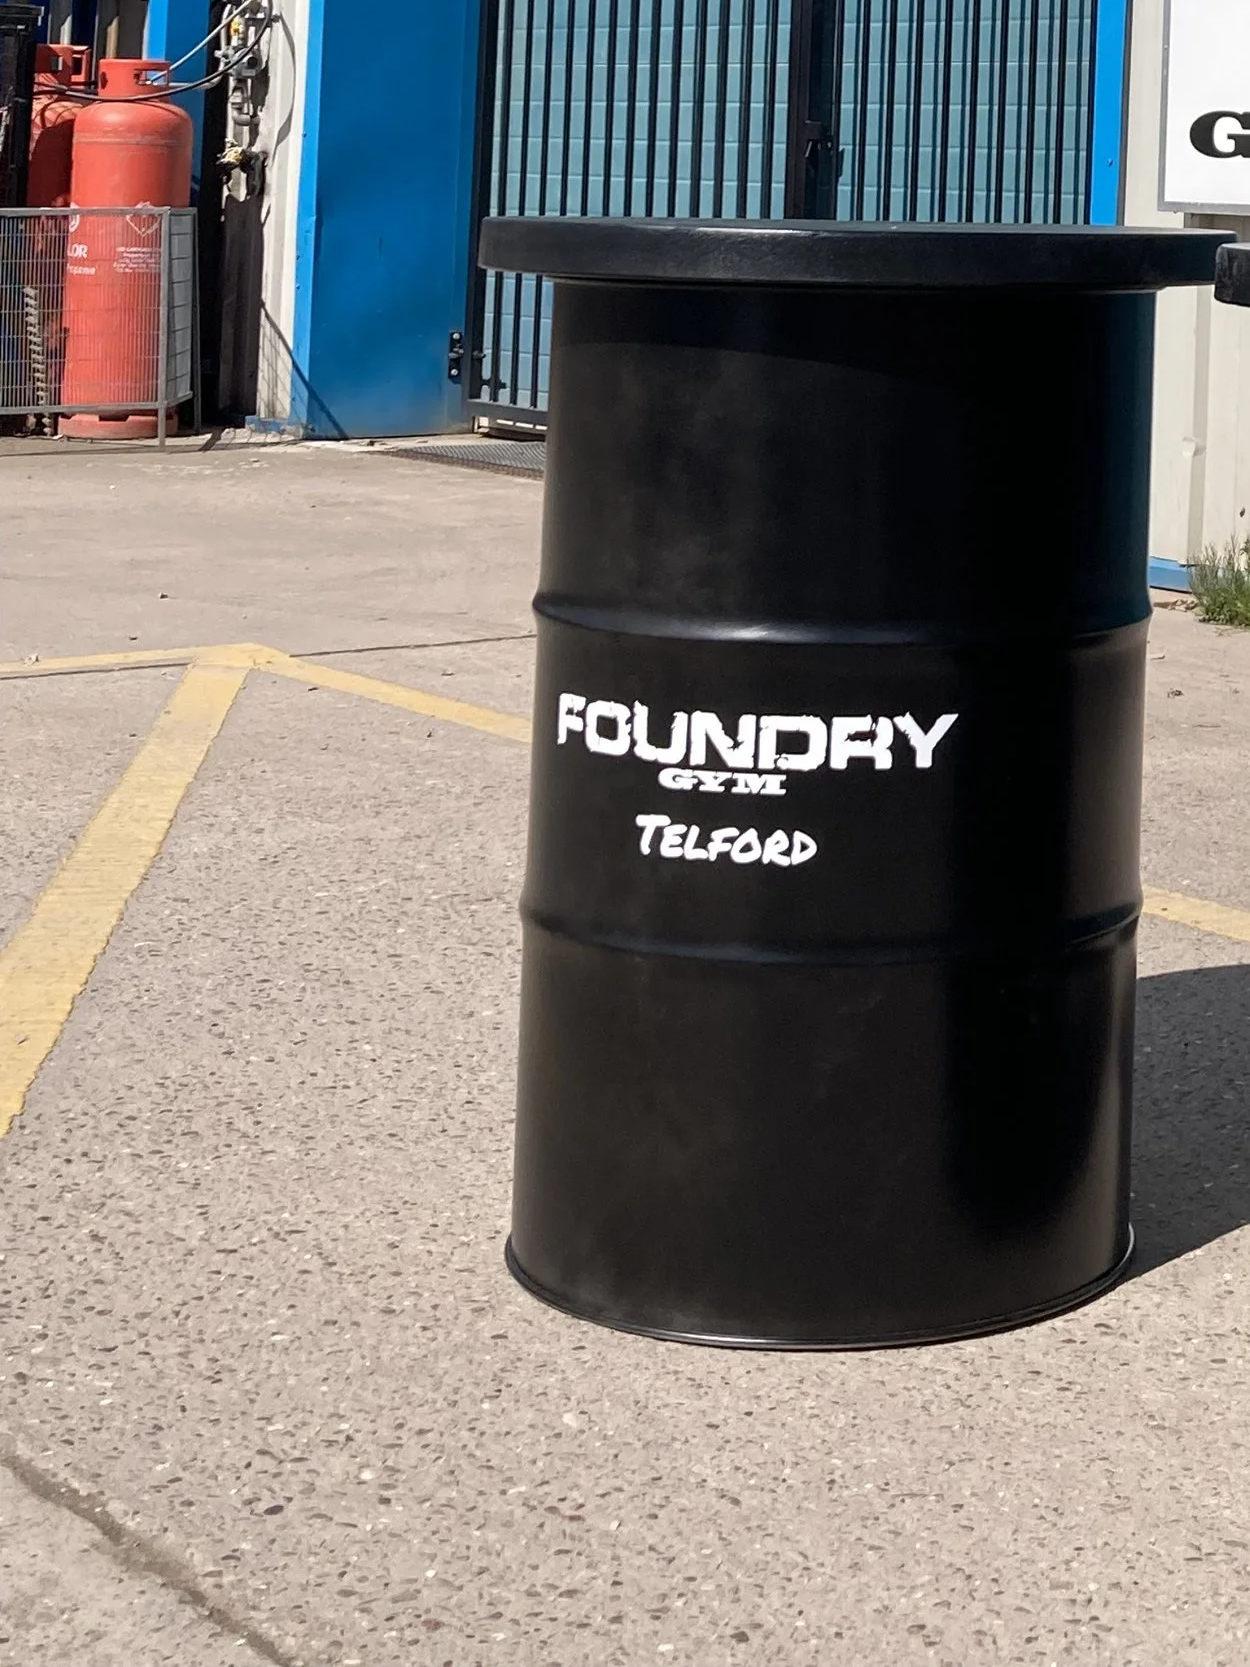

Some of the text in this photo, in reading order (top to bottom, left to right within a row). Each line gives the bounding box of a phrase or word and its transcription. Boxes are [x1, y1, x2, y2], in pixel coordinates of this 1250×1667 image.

[557, 692, 960, 772] FOUNDRY
[657, 767, 787, 796] GYM
[635, 814, 818, 867] TELFORD
